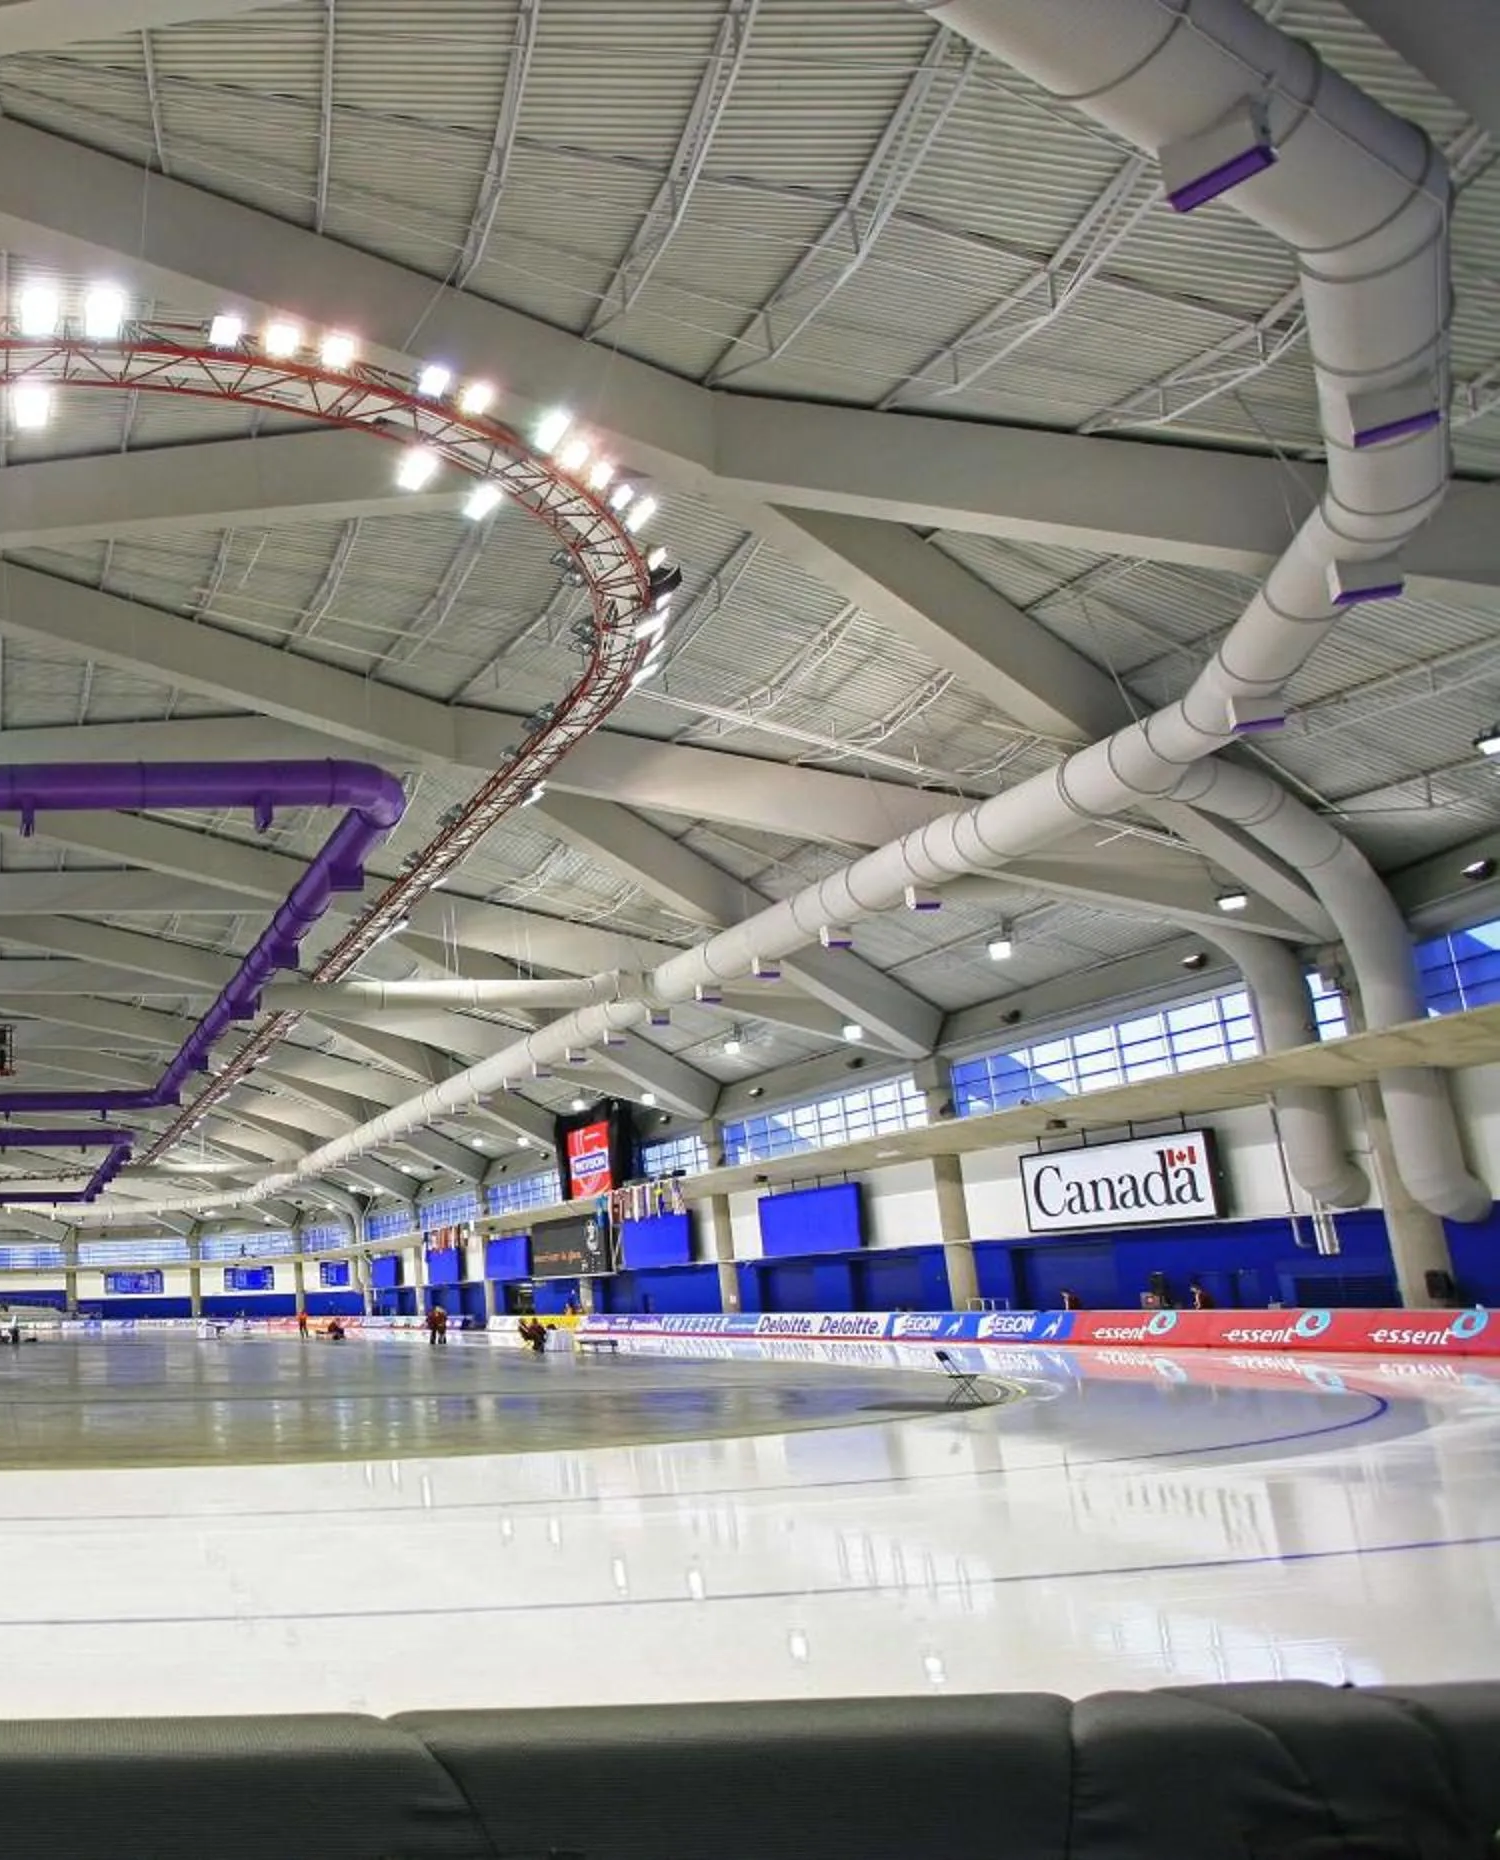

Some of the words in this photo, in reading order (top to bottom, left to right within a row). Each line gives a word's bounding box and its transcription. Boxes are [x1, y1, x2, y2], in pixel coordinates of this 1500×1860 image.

[1033, 1150, 1205, 1217] Canada
[759, 1315, 813, 1333] Deloitte.
[819, 1315, 881, 1335] Deloitte.
[1092, 1325, 1148, 1341] essent
[1222, 1327, 1300, 1344] essent
[1368, 1329, 1455, 1345] essent
